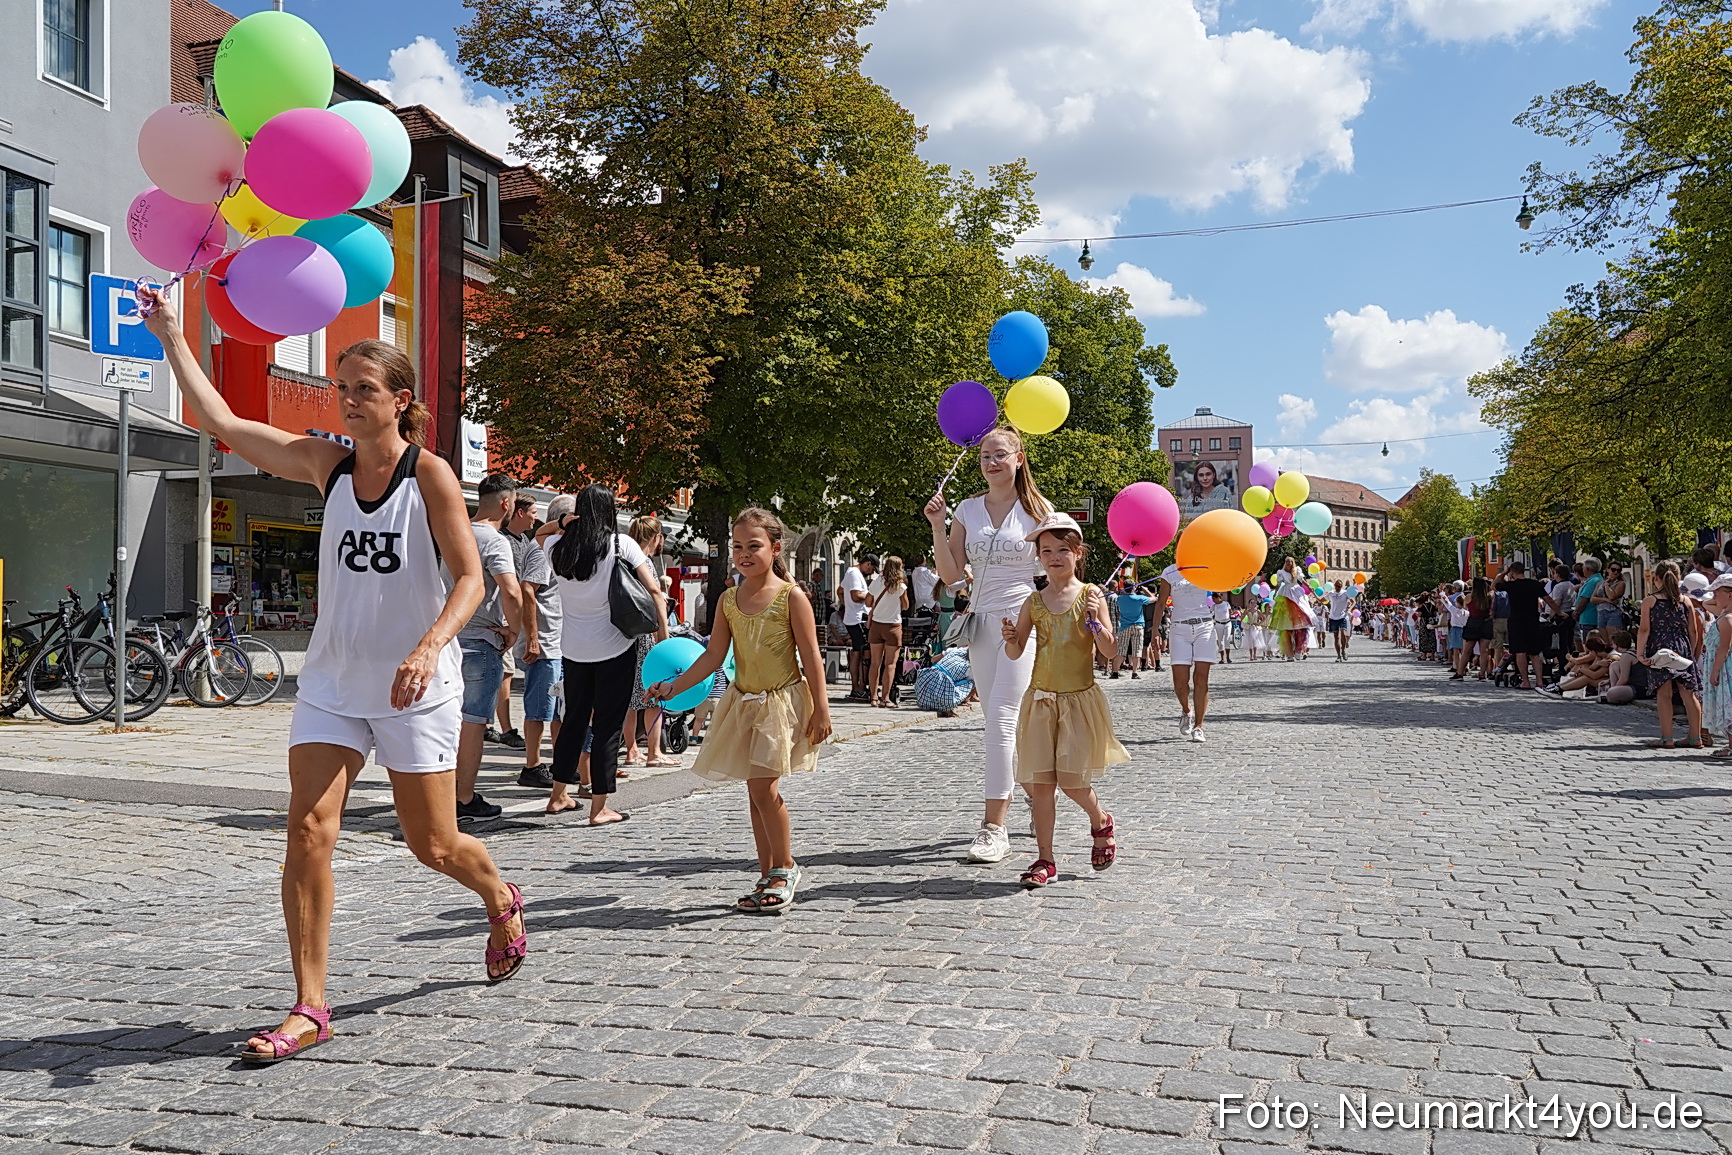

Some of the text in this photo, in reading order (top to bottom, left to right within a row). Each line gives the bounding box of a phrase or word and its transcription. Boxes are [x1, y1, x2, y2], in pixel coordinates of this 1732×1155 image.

[108, 286, 144, 347] P
[466, 458, 484, 469] PRESSE
[211, 522, 232, 532] OTTO
